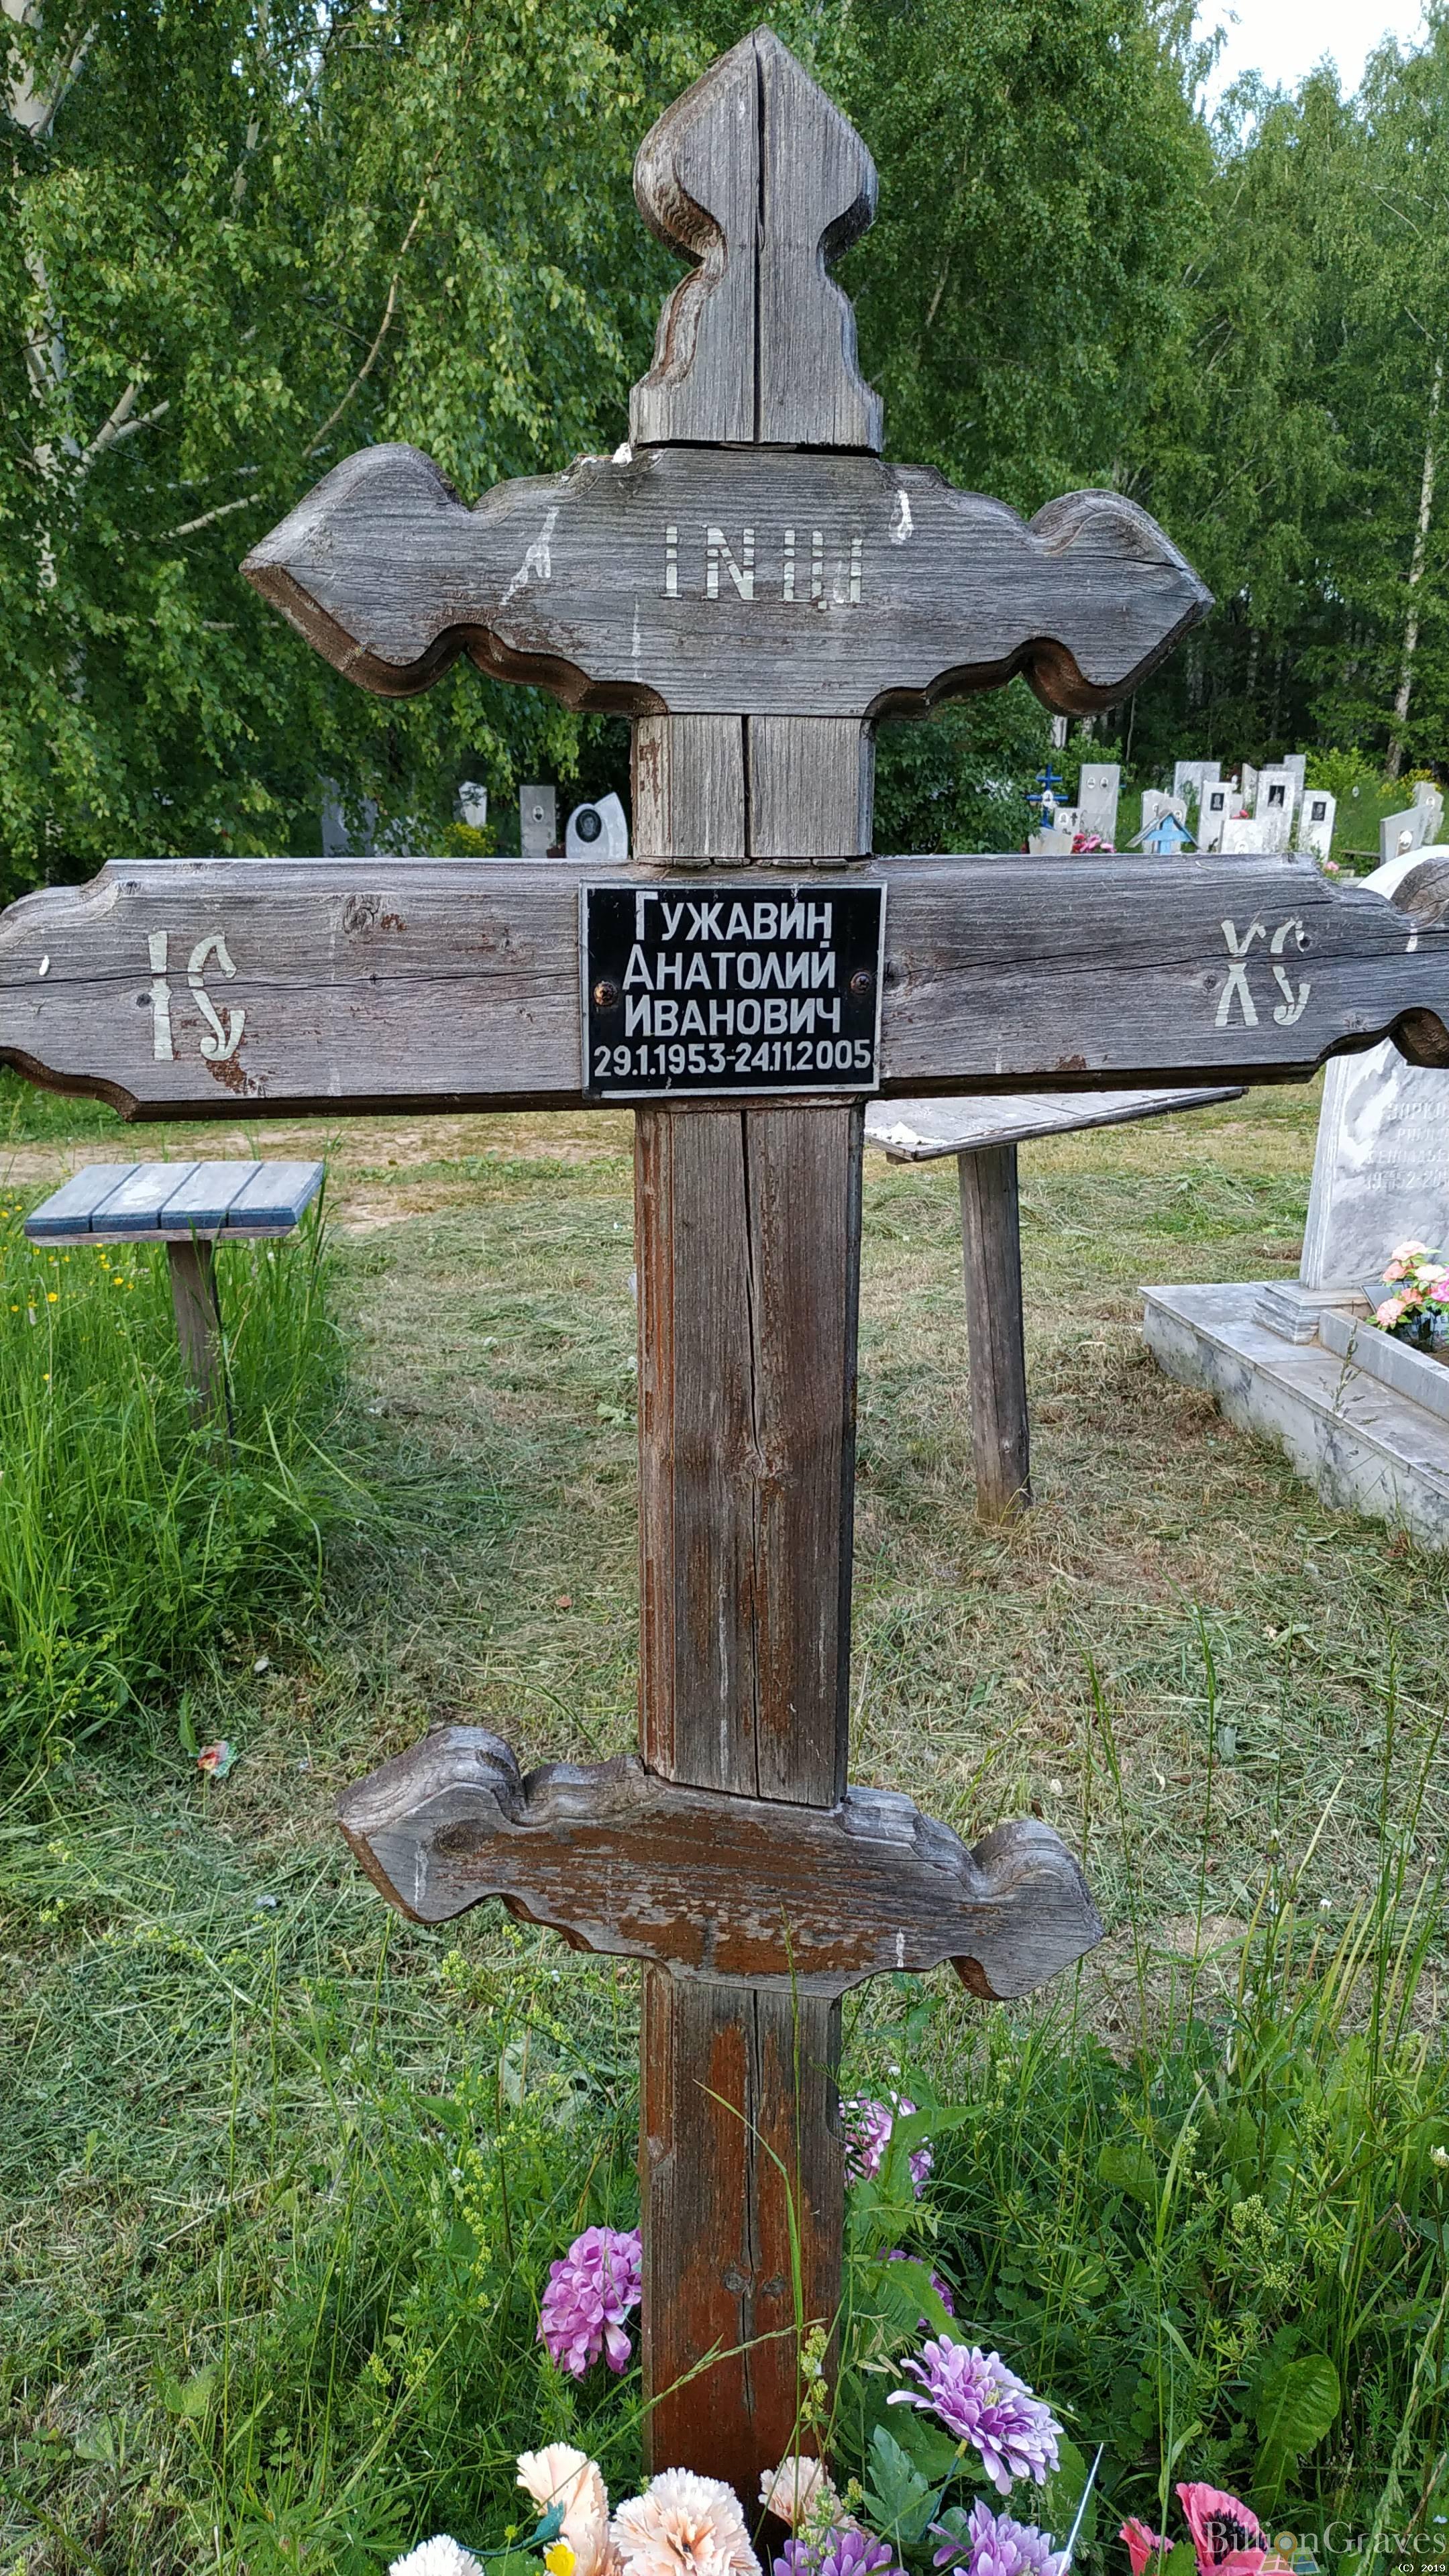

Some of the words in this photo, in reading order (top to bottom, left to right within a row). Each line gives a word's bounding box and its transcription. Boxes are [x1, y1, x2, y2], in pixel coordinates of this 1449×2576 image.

[635, 891, 833, 941] ГУЖАВИН
[622, 941, 836, 990] АНАТОЛИЙ
[625, 995, 841, 1037] ИВАНОВИЧ
